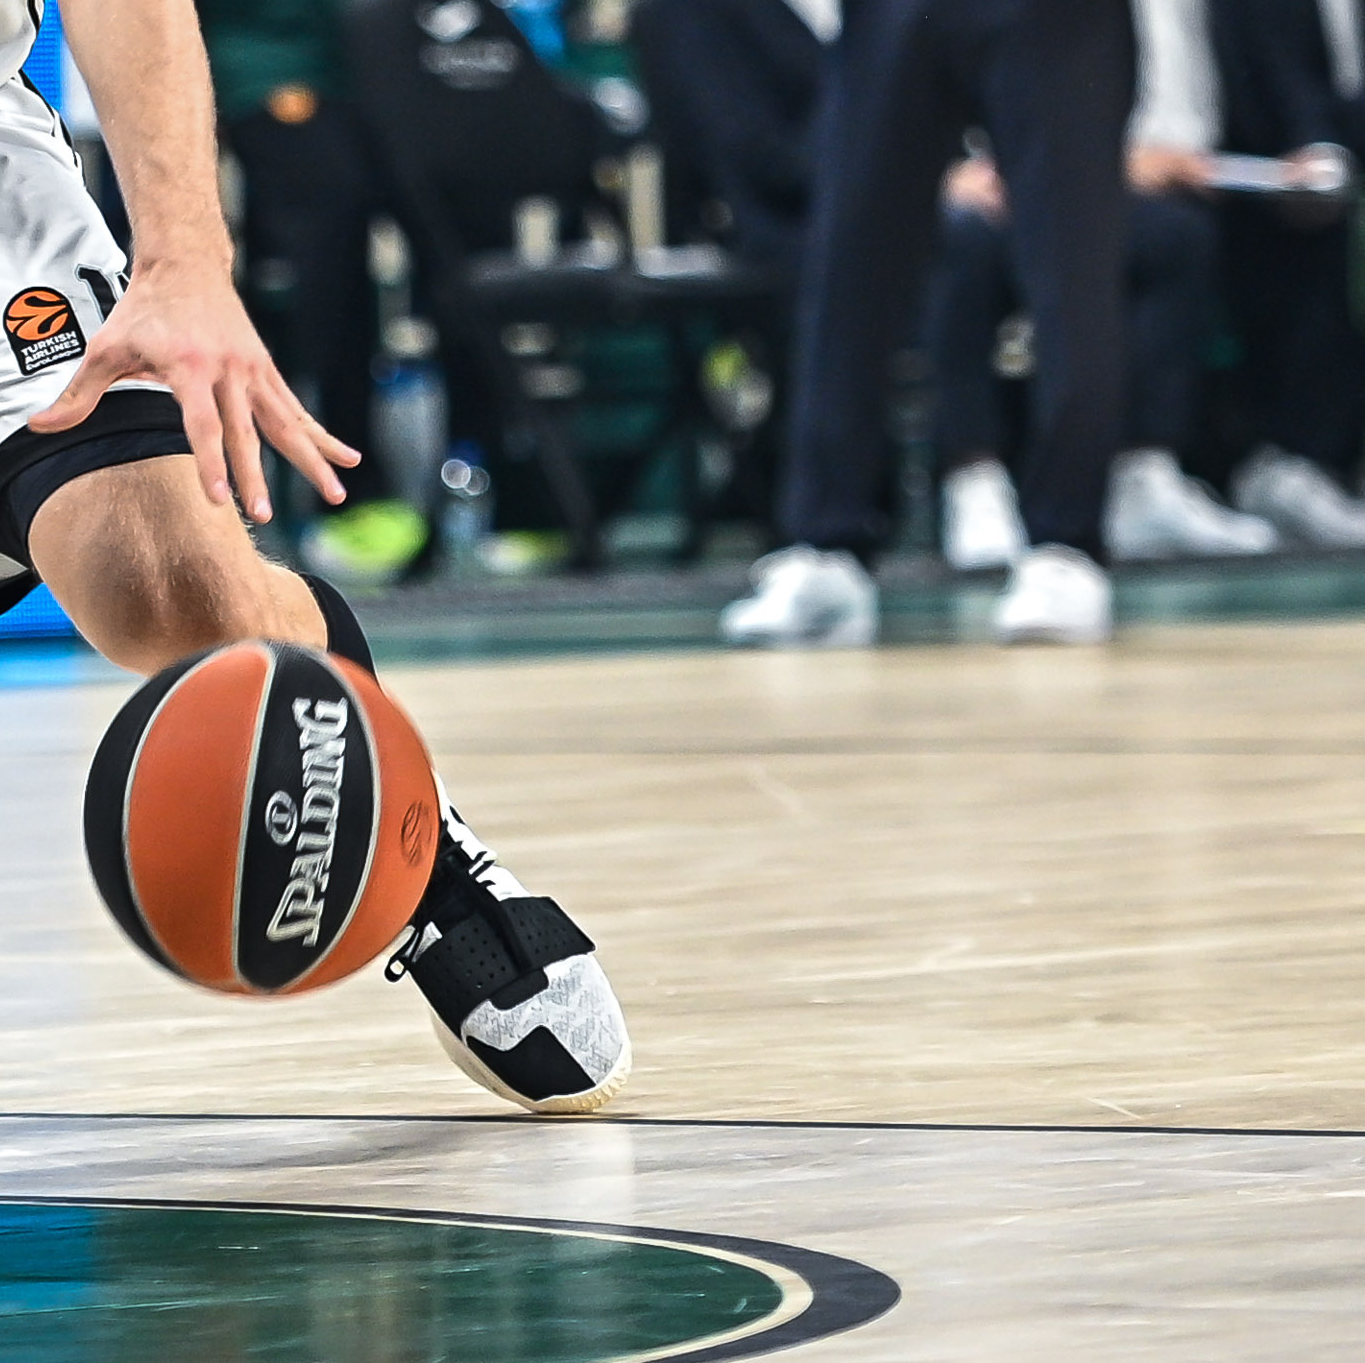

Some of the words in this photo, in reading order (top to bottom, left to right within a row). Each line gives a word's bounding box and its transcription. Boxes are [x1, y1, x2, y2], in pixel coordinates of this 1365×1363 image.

[21, 331, 76, 356] TURKISH
[25, 339, 79, 364] AIRLINES
[266, 697, 348, 947] SPALDING
